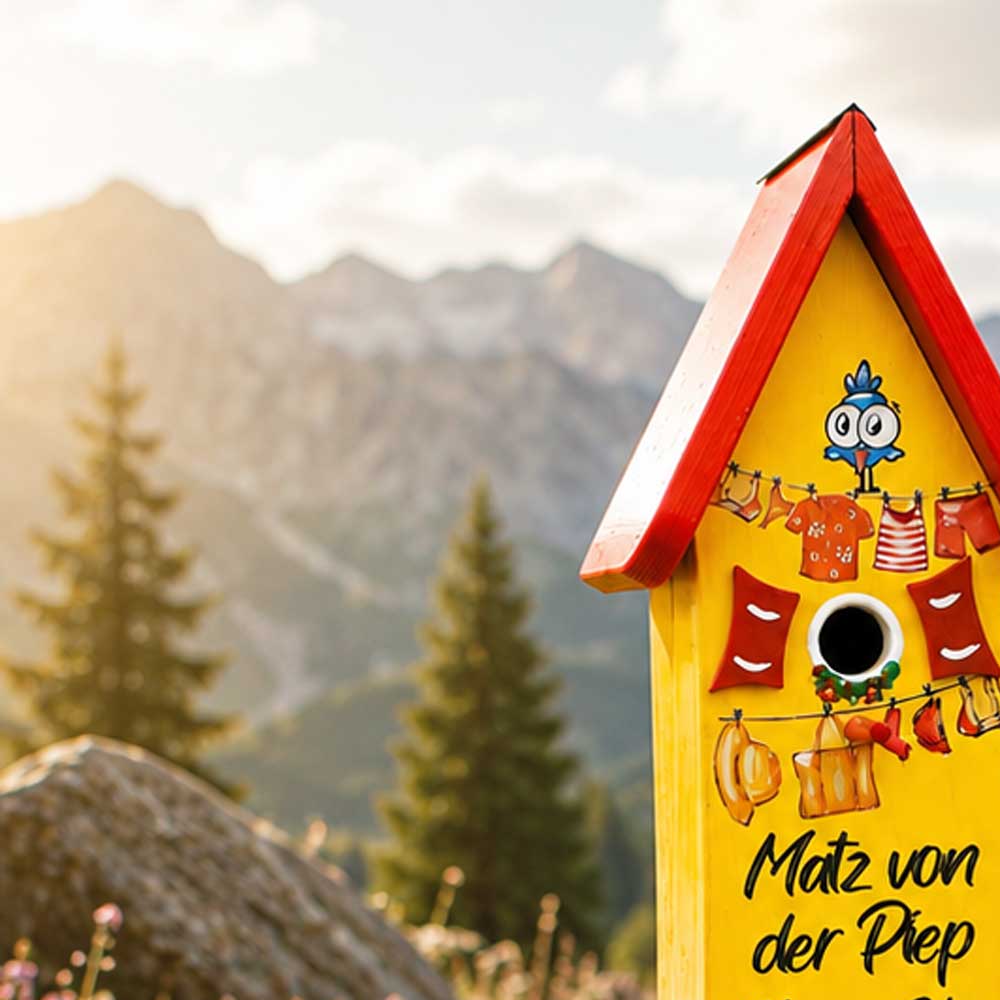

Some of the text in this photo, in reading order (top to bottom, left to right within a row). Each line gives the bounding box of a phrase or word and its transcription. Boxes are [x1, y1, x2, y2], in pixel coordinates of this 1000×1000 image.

[743, 829, 981, 900] Matz von
[752, 899, 976, 988] der Piep
